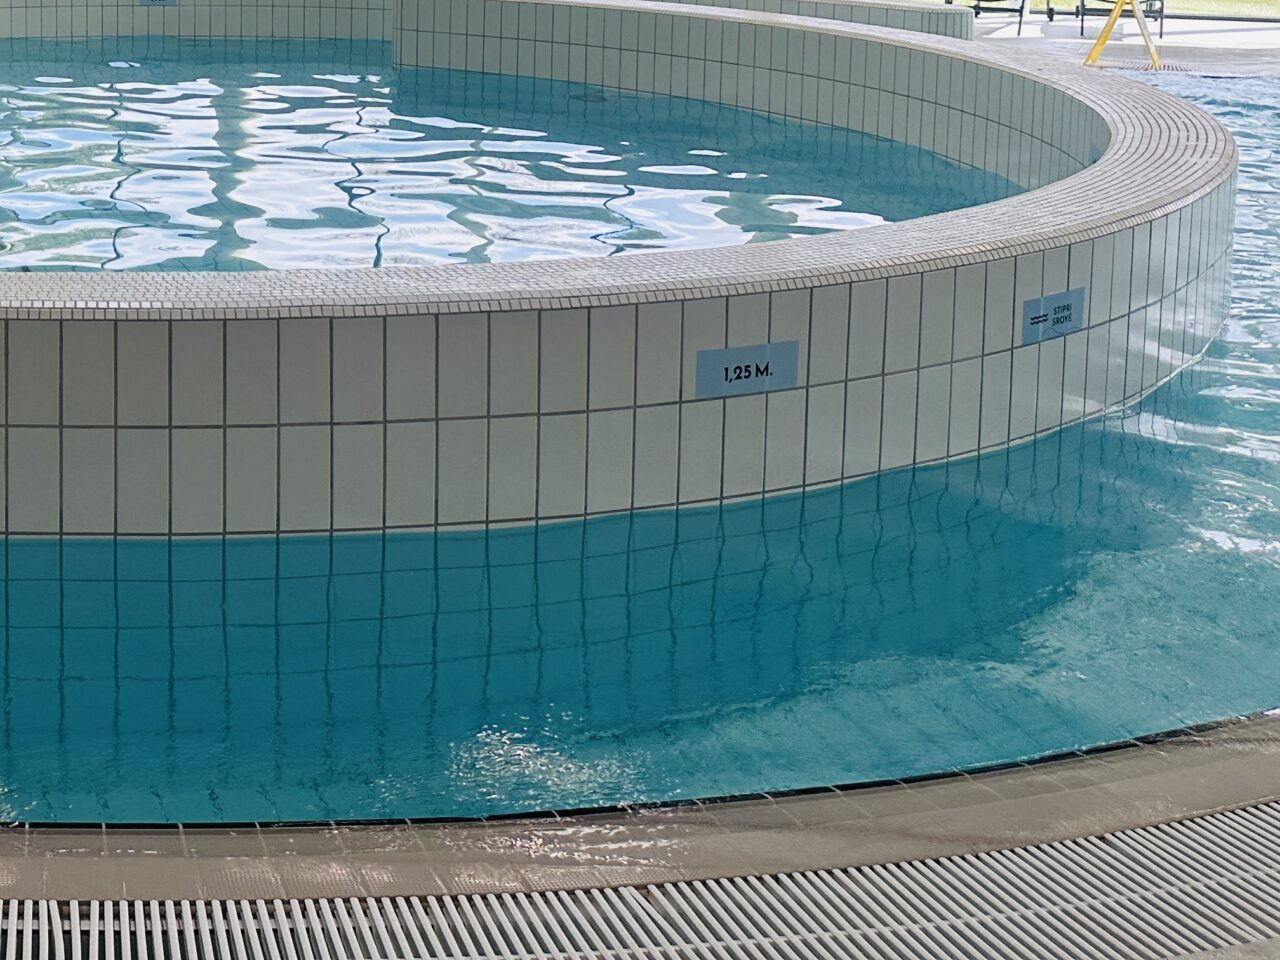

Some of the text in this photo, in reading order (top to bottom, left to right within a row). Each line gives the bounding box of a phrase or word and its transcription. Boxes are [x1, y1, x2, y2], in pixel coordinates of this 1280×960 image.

[1053, 303, 1072, 315] STIPRI
[724, 361, 773, 384] 1,25 M.
